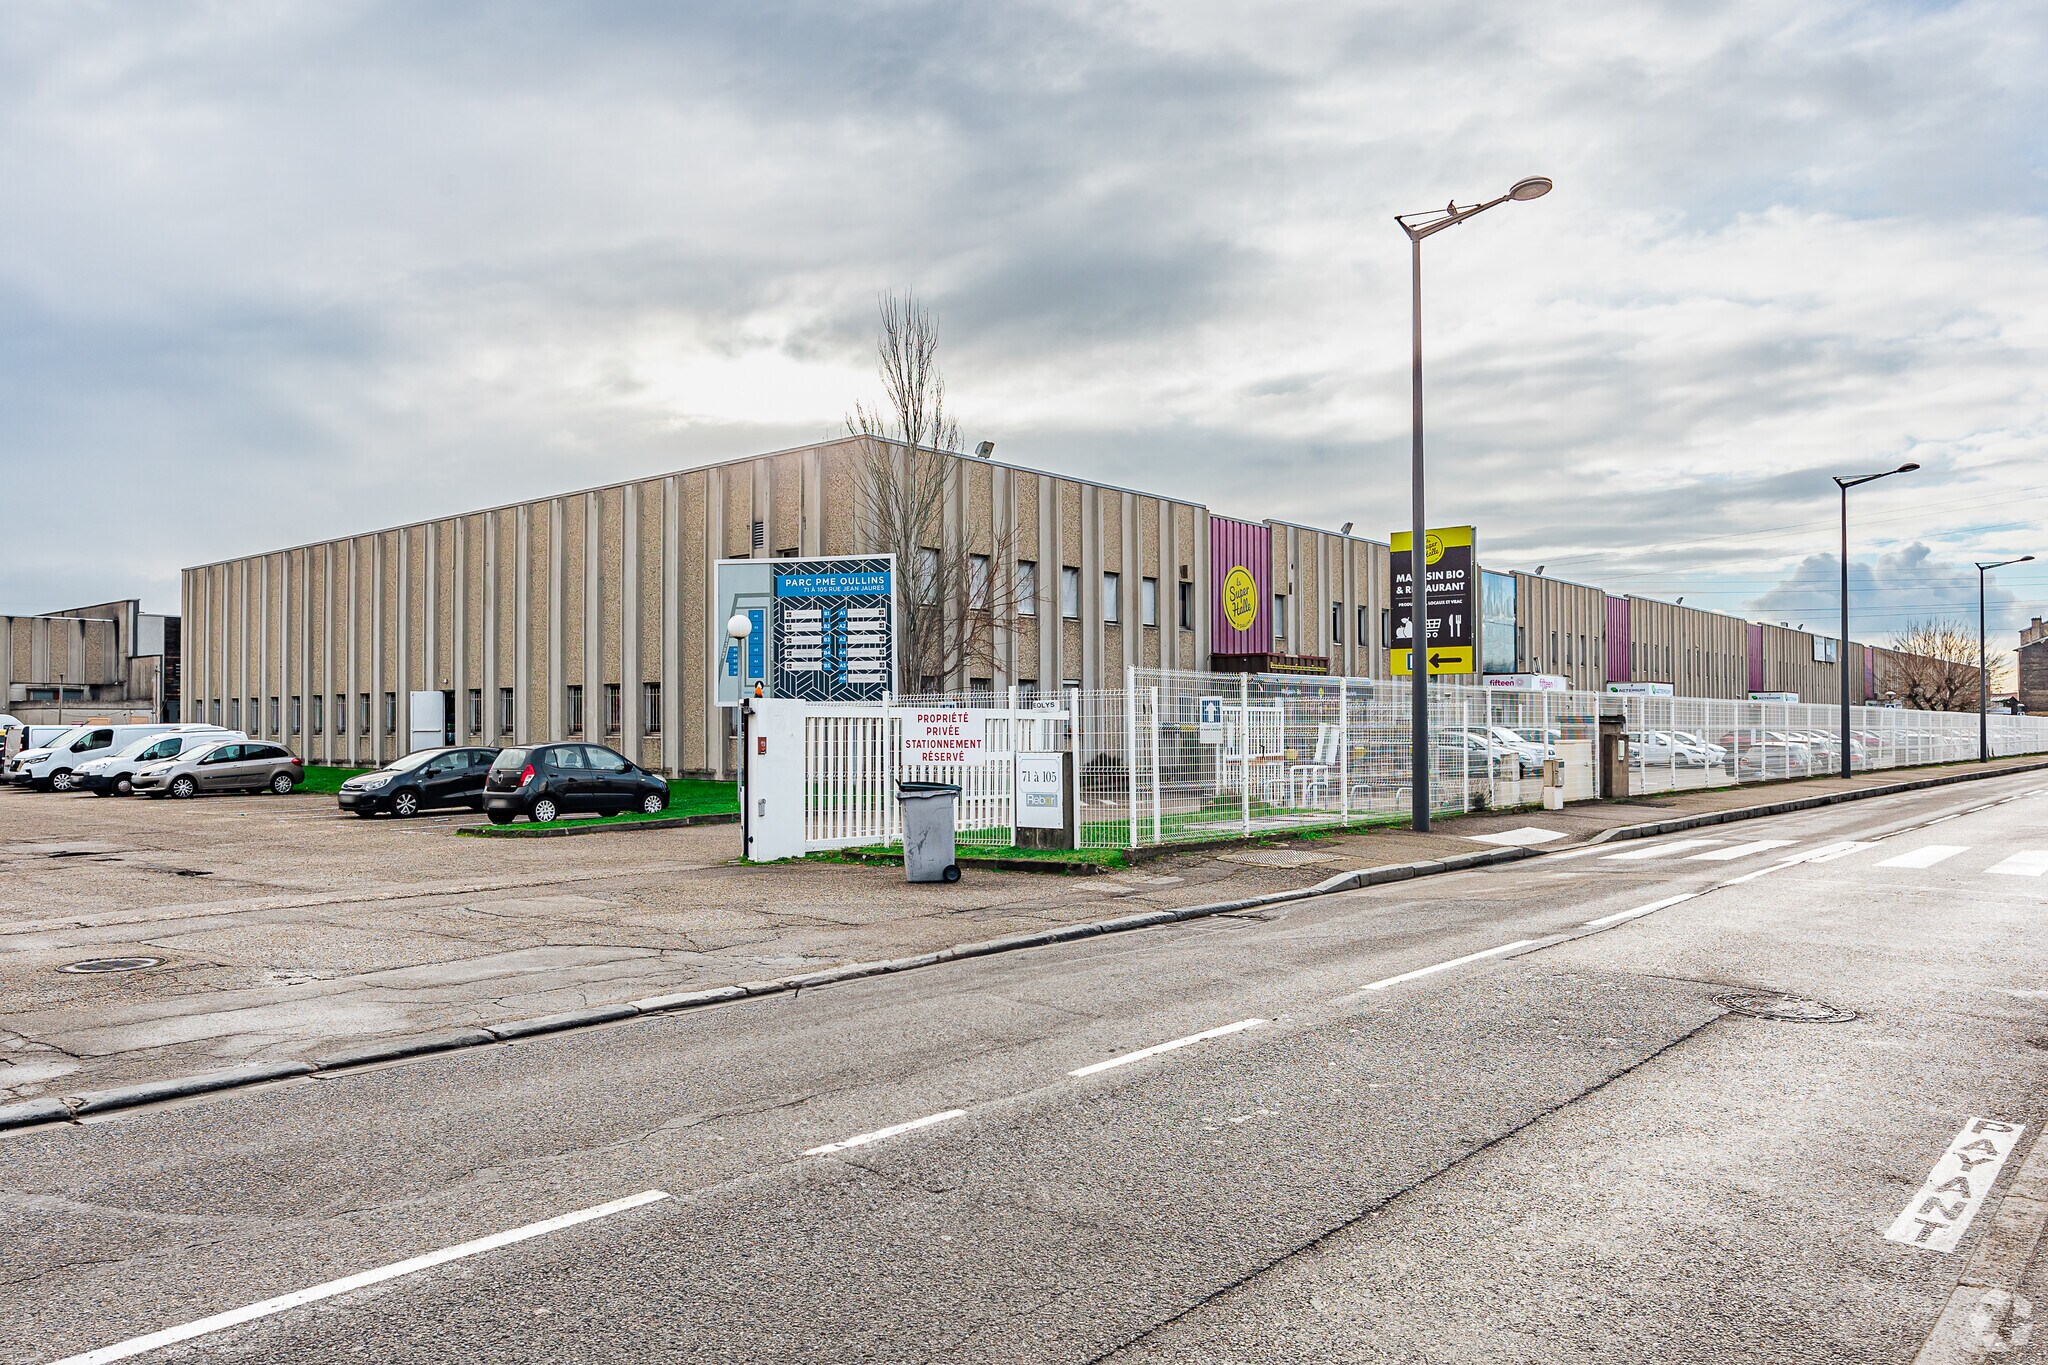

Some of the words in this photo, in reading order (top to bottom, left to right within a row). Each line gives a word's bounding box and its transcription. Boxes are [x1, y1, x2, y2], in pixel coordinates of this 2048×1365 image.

[785, 578, 812, 587] PARC
[816, 577, 836, 586] PME
[840, 576, 885, 585] OULLINS
[1396, 571, 1444, 583] MASIN
[1446, 570, 1464, 579] BIO
[1396, 586, 1404, 594] &
[1405, 582, 1465, 594] RAURANT
[1230, 586, 1250, 603] Super
[1232, 598, 1251, 617] Halle
[918, 712, 969, 723] PROPRIÉTÉ
[926, 725, 960, 736] PRIVÉE
[906, 740, 982, 748] STATIONNEMENT
[922, 751, 964, 762] RÉSERVÉ
[1022, 770, 1030, 782] 71
[1034, 771, 1040, 782] à
[1043, 771, 1057, 782] 105
[1912, 1119, 2015, 1244] PAYANT
